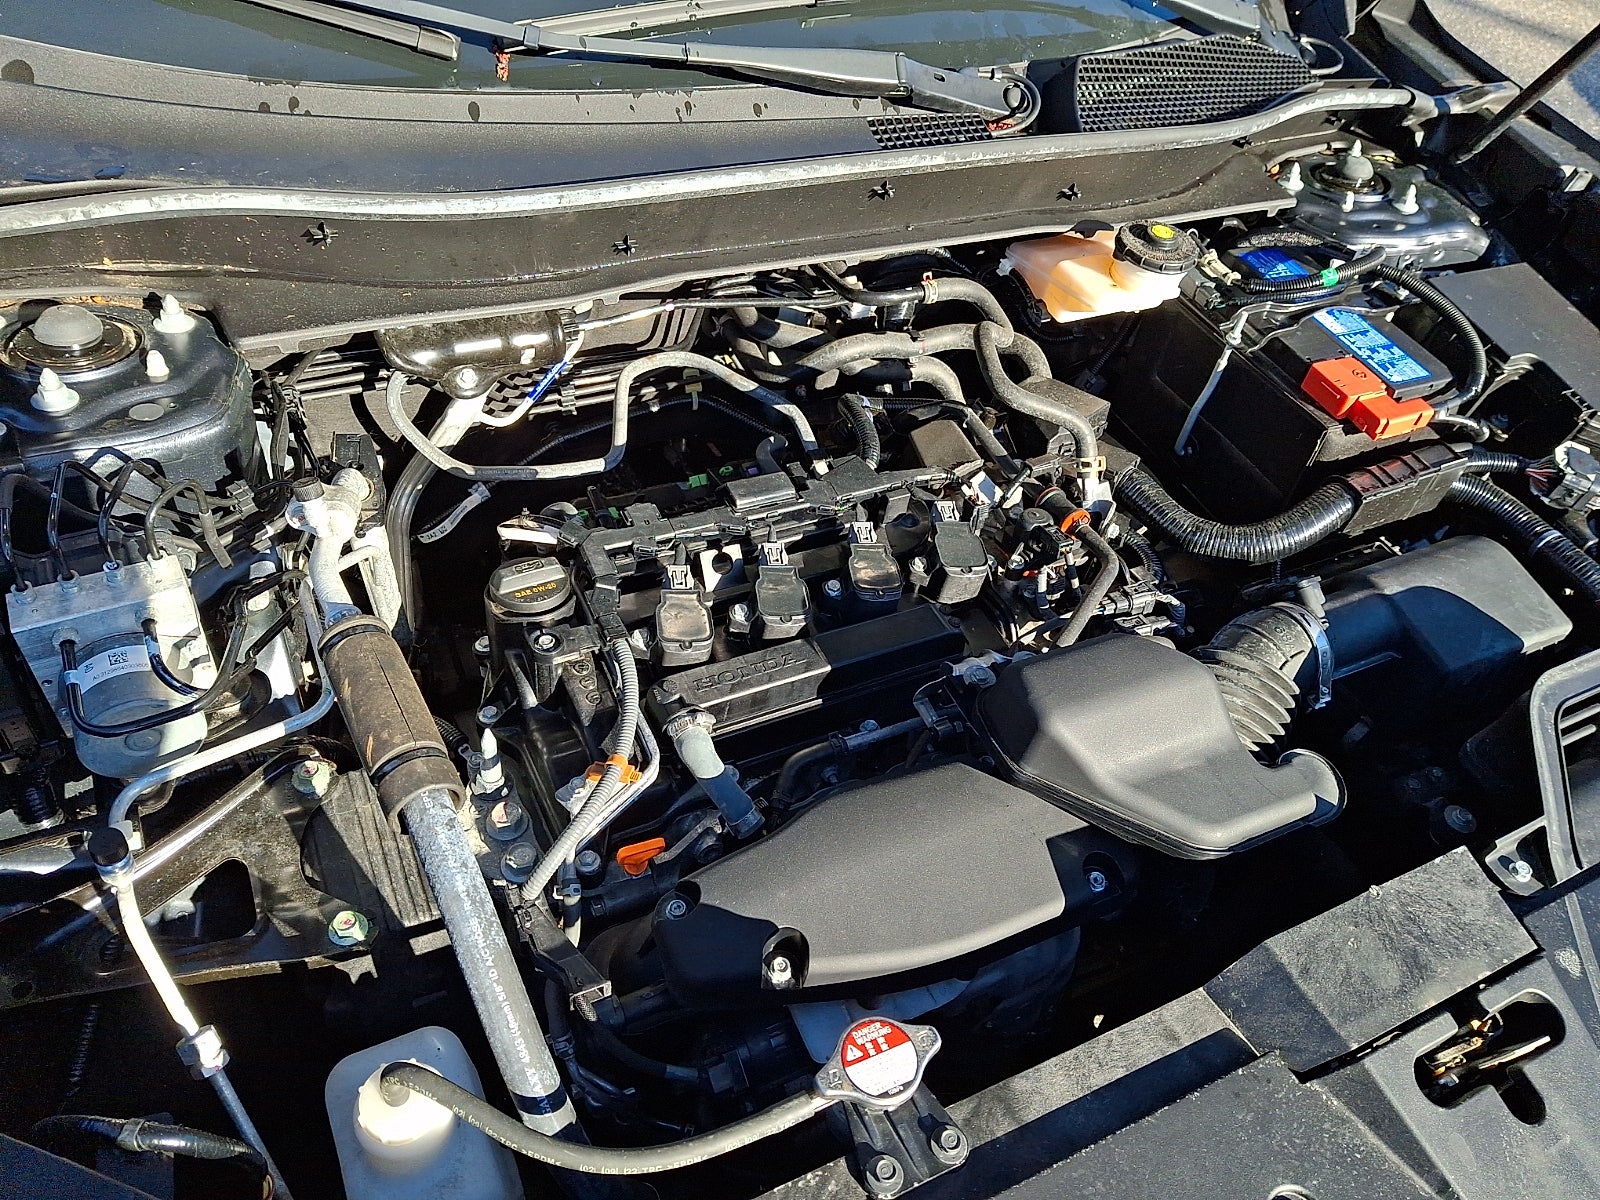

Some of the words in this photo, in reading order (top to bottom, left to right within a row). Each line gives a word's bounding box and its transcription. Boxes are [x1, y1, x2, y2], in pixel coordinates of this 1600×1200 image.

[515, 590, 532, 598] SAE
[532, 582, 556, 593] 0W-20
[692, 652, 806, 692] HONDA
[468, 917, 486, 947] HOSE
[852, 1022, 883, 1039] DANGER
[855, 1026, 892, 1046] WARNING
[514, 1038, 531, 1064] 4843
